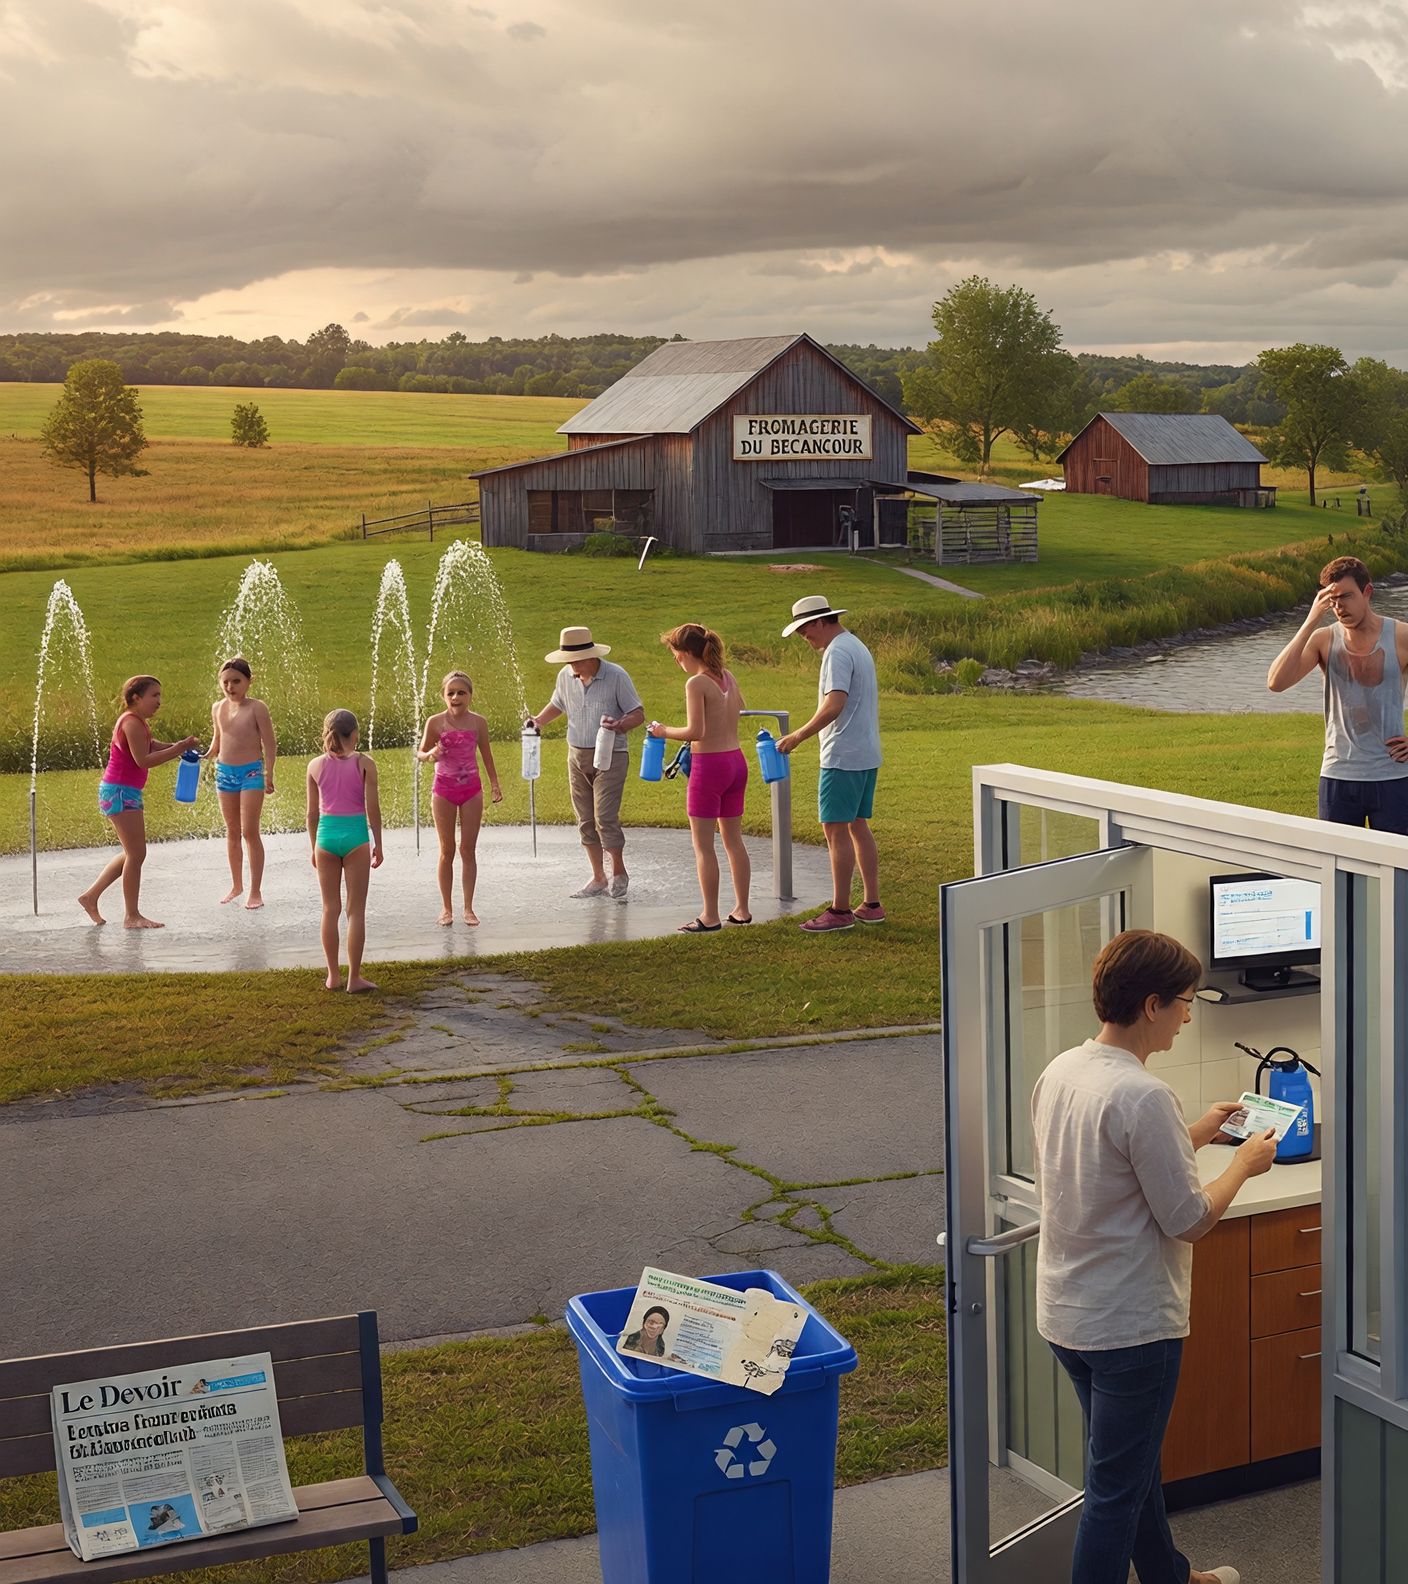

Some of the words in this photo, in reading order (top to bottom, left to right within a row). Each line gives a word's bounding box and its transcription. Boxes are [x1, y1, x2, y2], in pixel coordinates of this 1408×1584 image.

[748, 419, 859, 436] FROMAGERIE
[741, 440, 762, 455] DU
[770, 438, 864, 455] BECANCOUR
[60, 1391, 94, 1415] Le
[99, 1375, 182, 1409] Devoir
